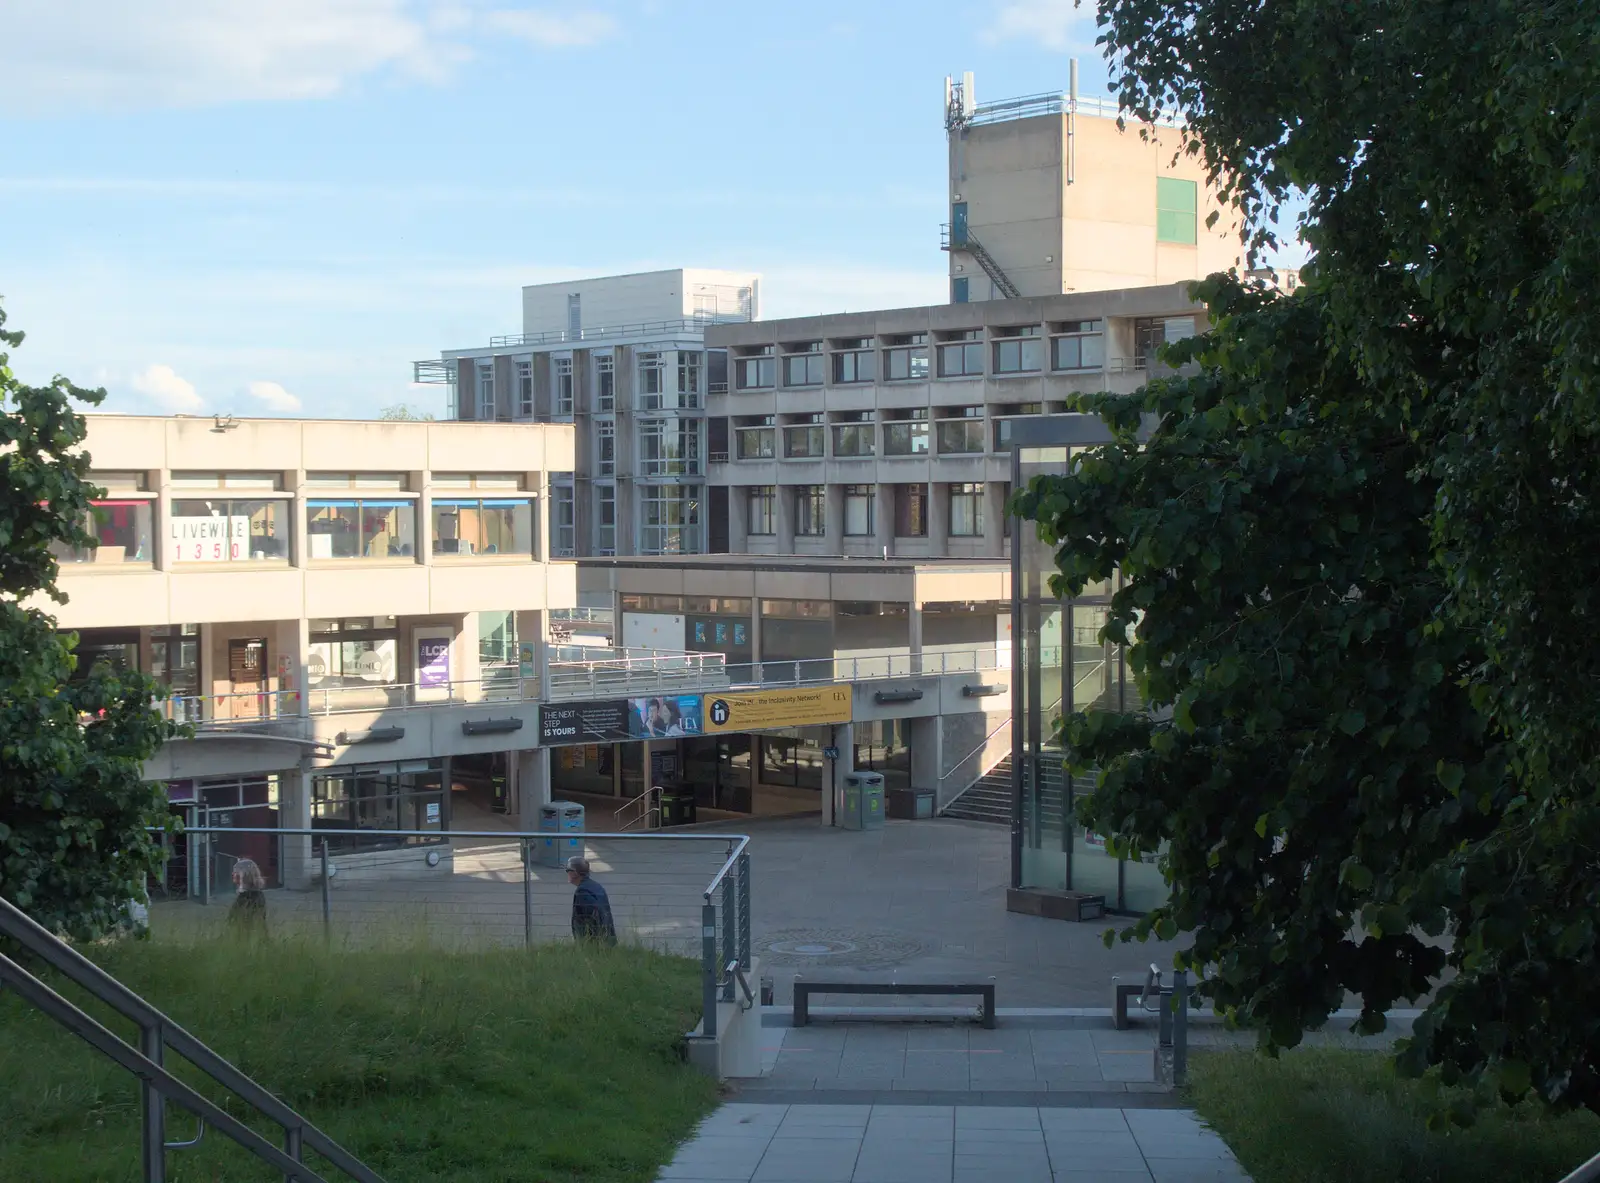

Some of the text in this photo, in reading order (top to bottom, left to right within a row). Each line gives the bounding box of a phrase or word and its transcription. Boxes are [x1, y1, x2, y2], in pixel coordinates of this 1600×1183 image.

[425, 644, 448, 657] LCR
[768, 696, 796, 705] Inclusivity
[544, 710, 576, 720] THE NEXT
[544, 720, 561, 729] STEP
[544, 727, 576, 737] IS YOURS
